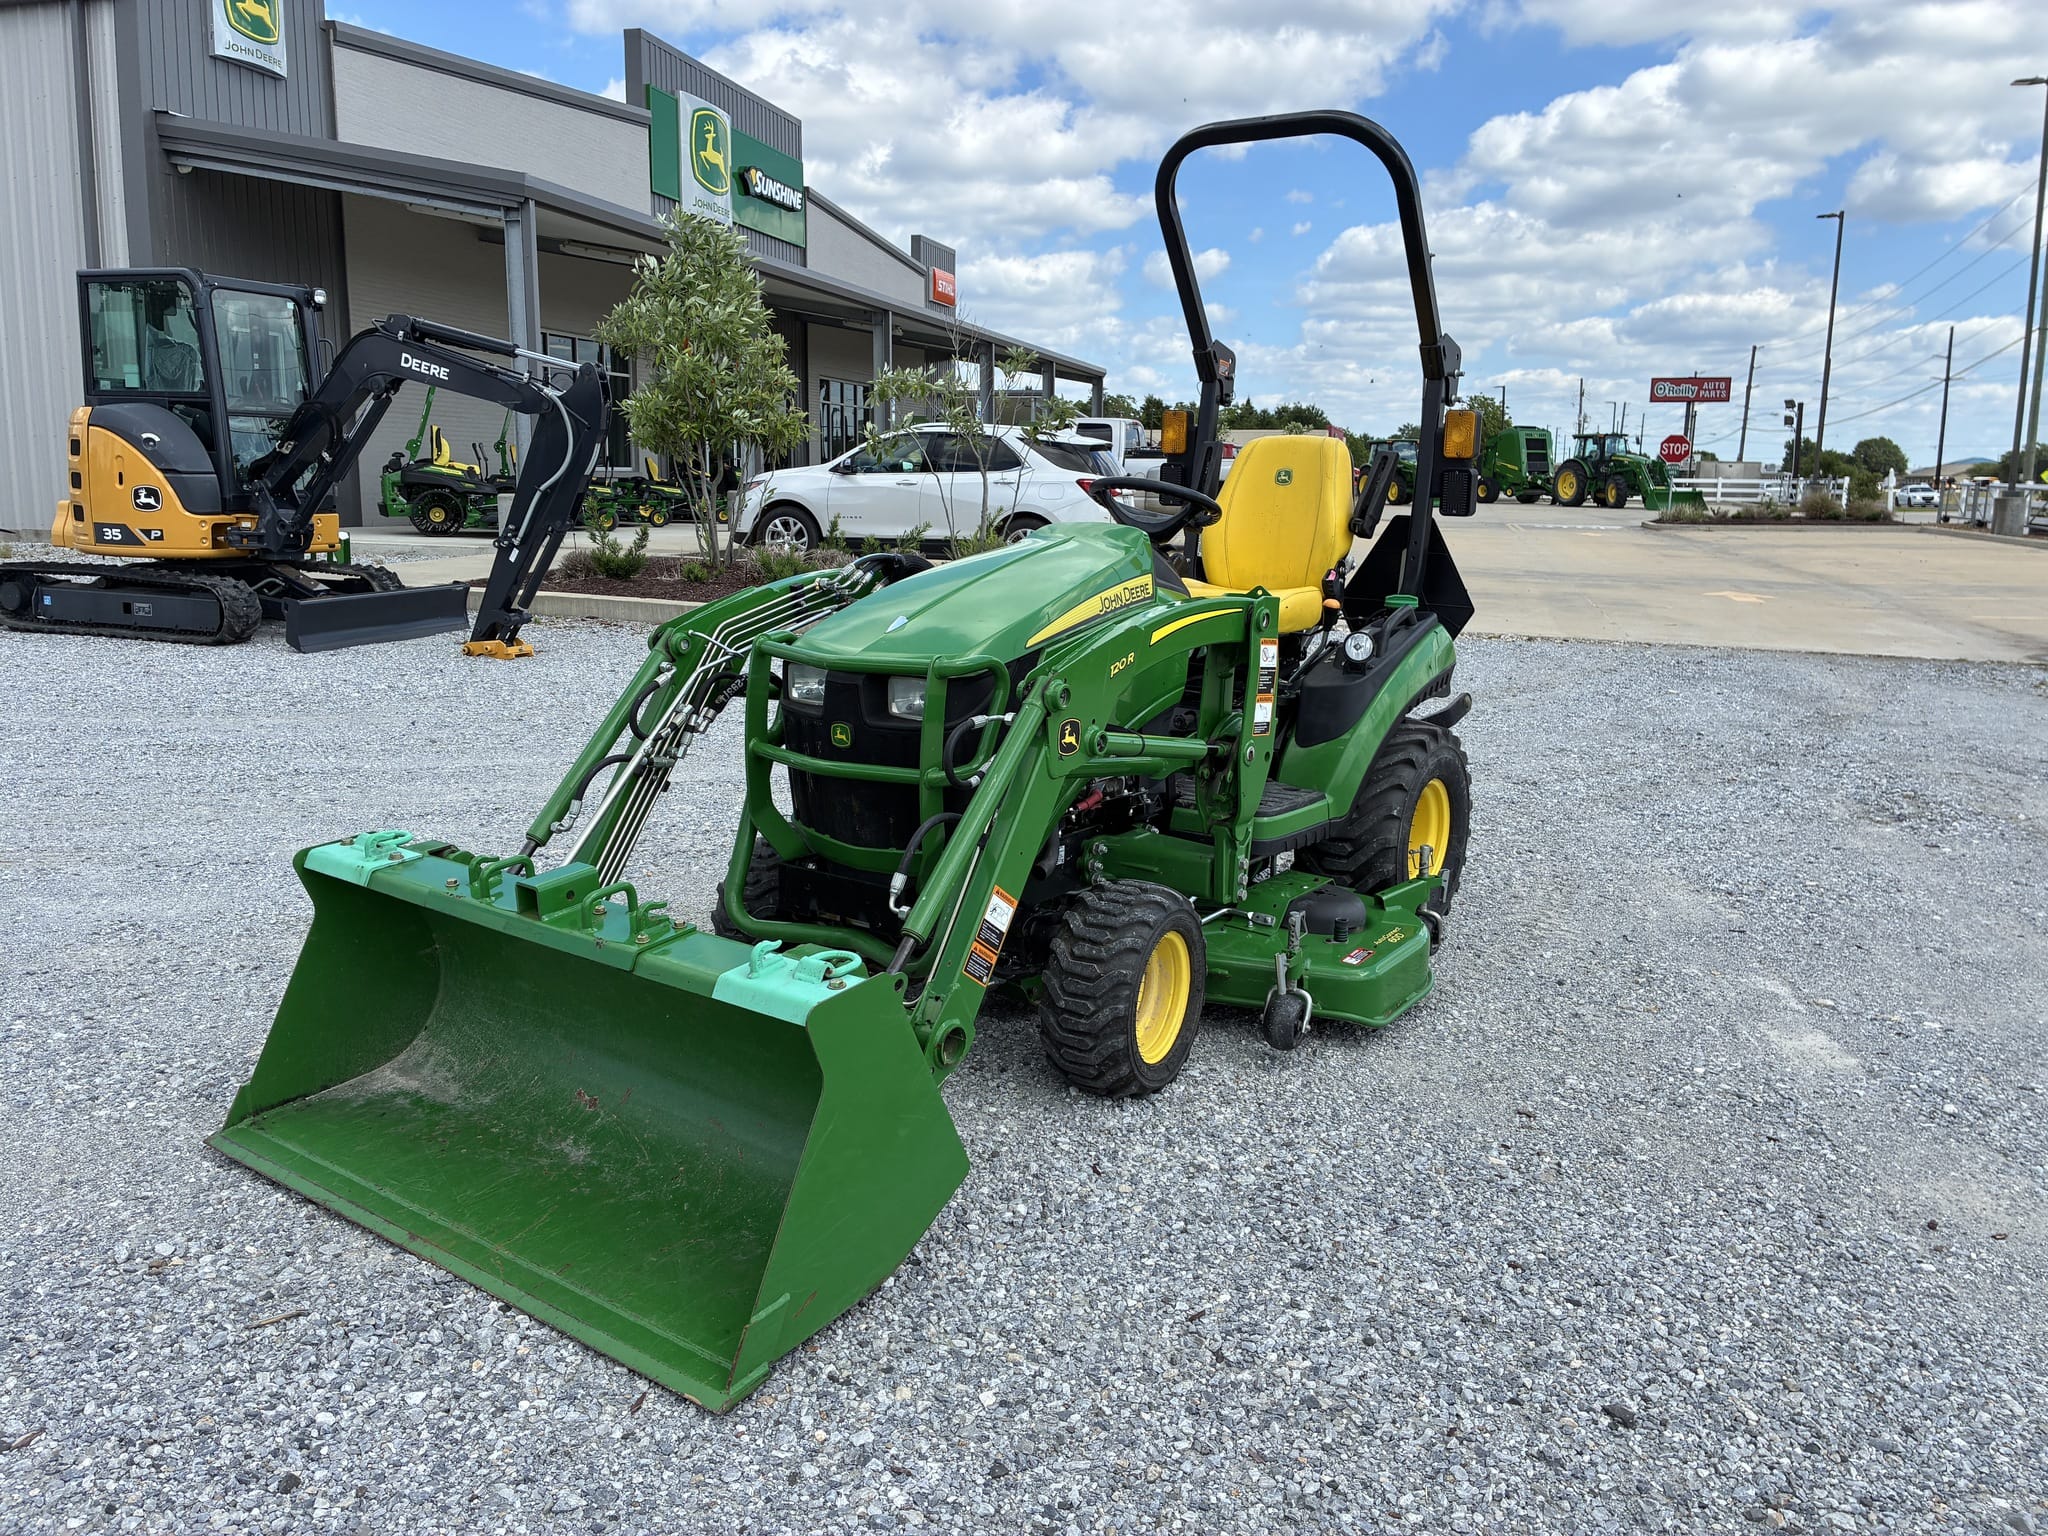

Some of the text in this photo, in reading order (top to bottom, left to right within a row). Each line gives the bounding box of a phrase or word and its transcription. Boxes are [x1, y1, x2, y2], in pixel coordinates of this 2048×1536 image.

[224, 40, 283, 69] JOHN DEERE
[754, 171, 803, 210] SUNSHINE
[692, 196, 730, 219] JOHN DEERE
[400, 352, 450, 380] DEERE
[1654, 382, 1698, 398] O'Reilly
[1699, 389, 1727, 398] PARTS
[1703, 381, 1726, 390] AUTO
[1661, 442, 1689, 455] STOP
[102, 528, 122, 540] 35
[150, 530, 162, 540] P
[1098, 582, 1151, 614] JOHN DEERE
